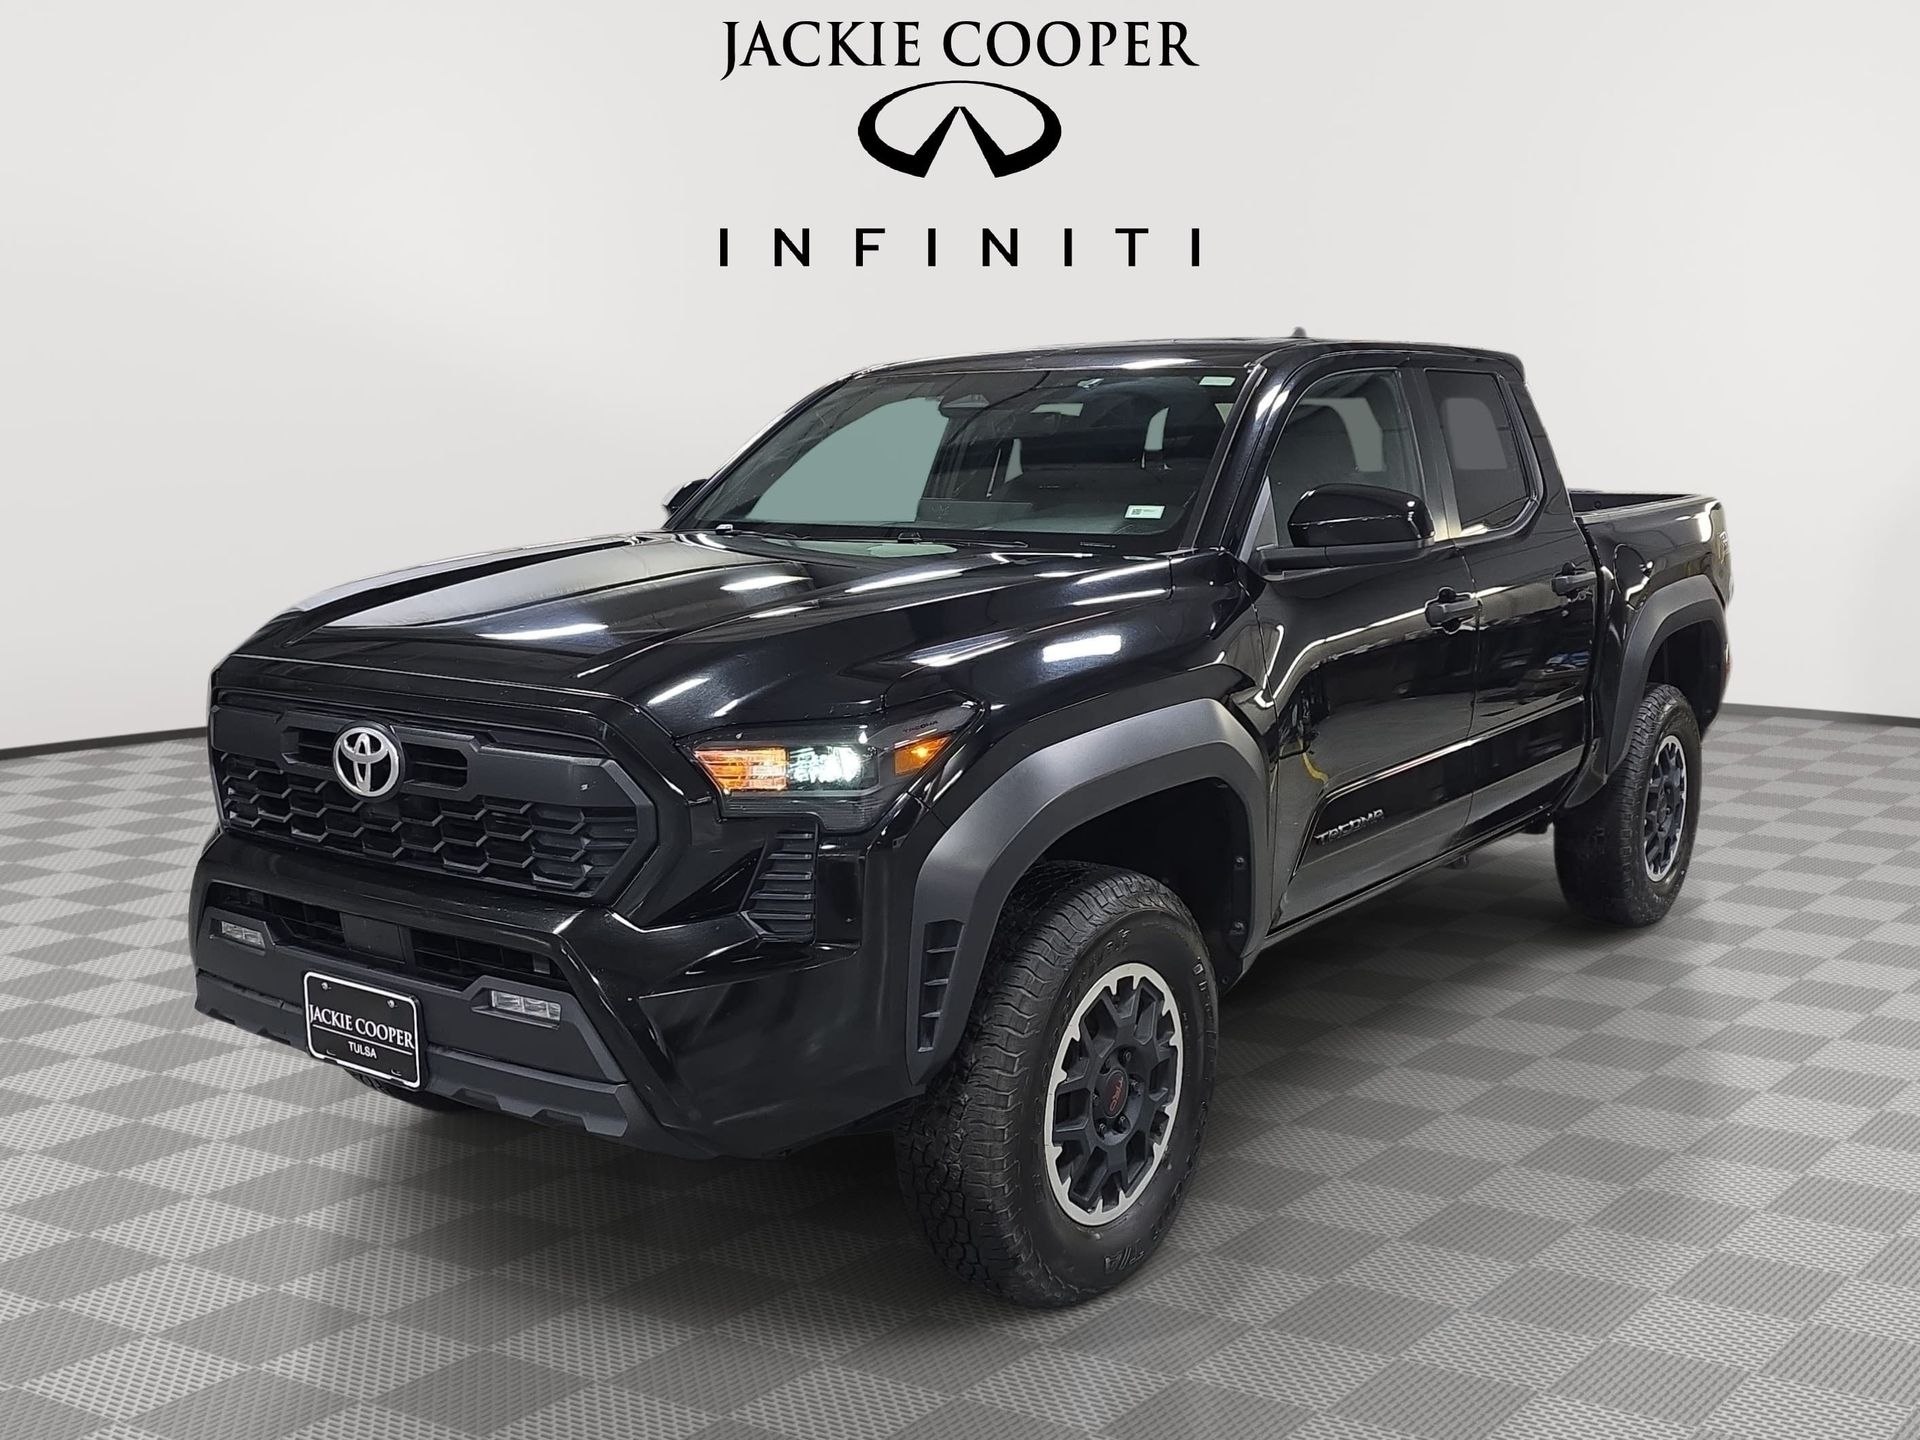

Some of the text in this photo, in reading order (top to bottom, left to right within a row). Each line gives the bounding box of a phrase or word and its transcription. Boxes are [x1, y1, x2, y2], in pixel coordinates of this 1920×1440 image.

[309, 1004, 415, 1049] JACKIE COOPER
[347, 1041, 378, 1060] TULSA
